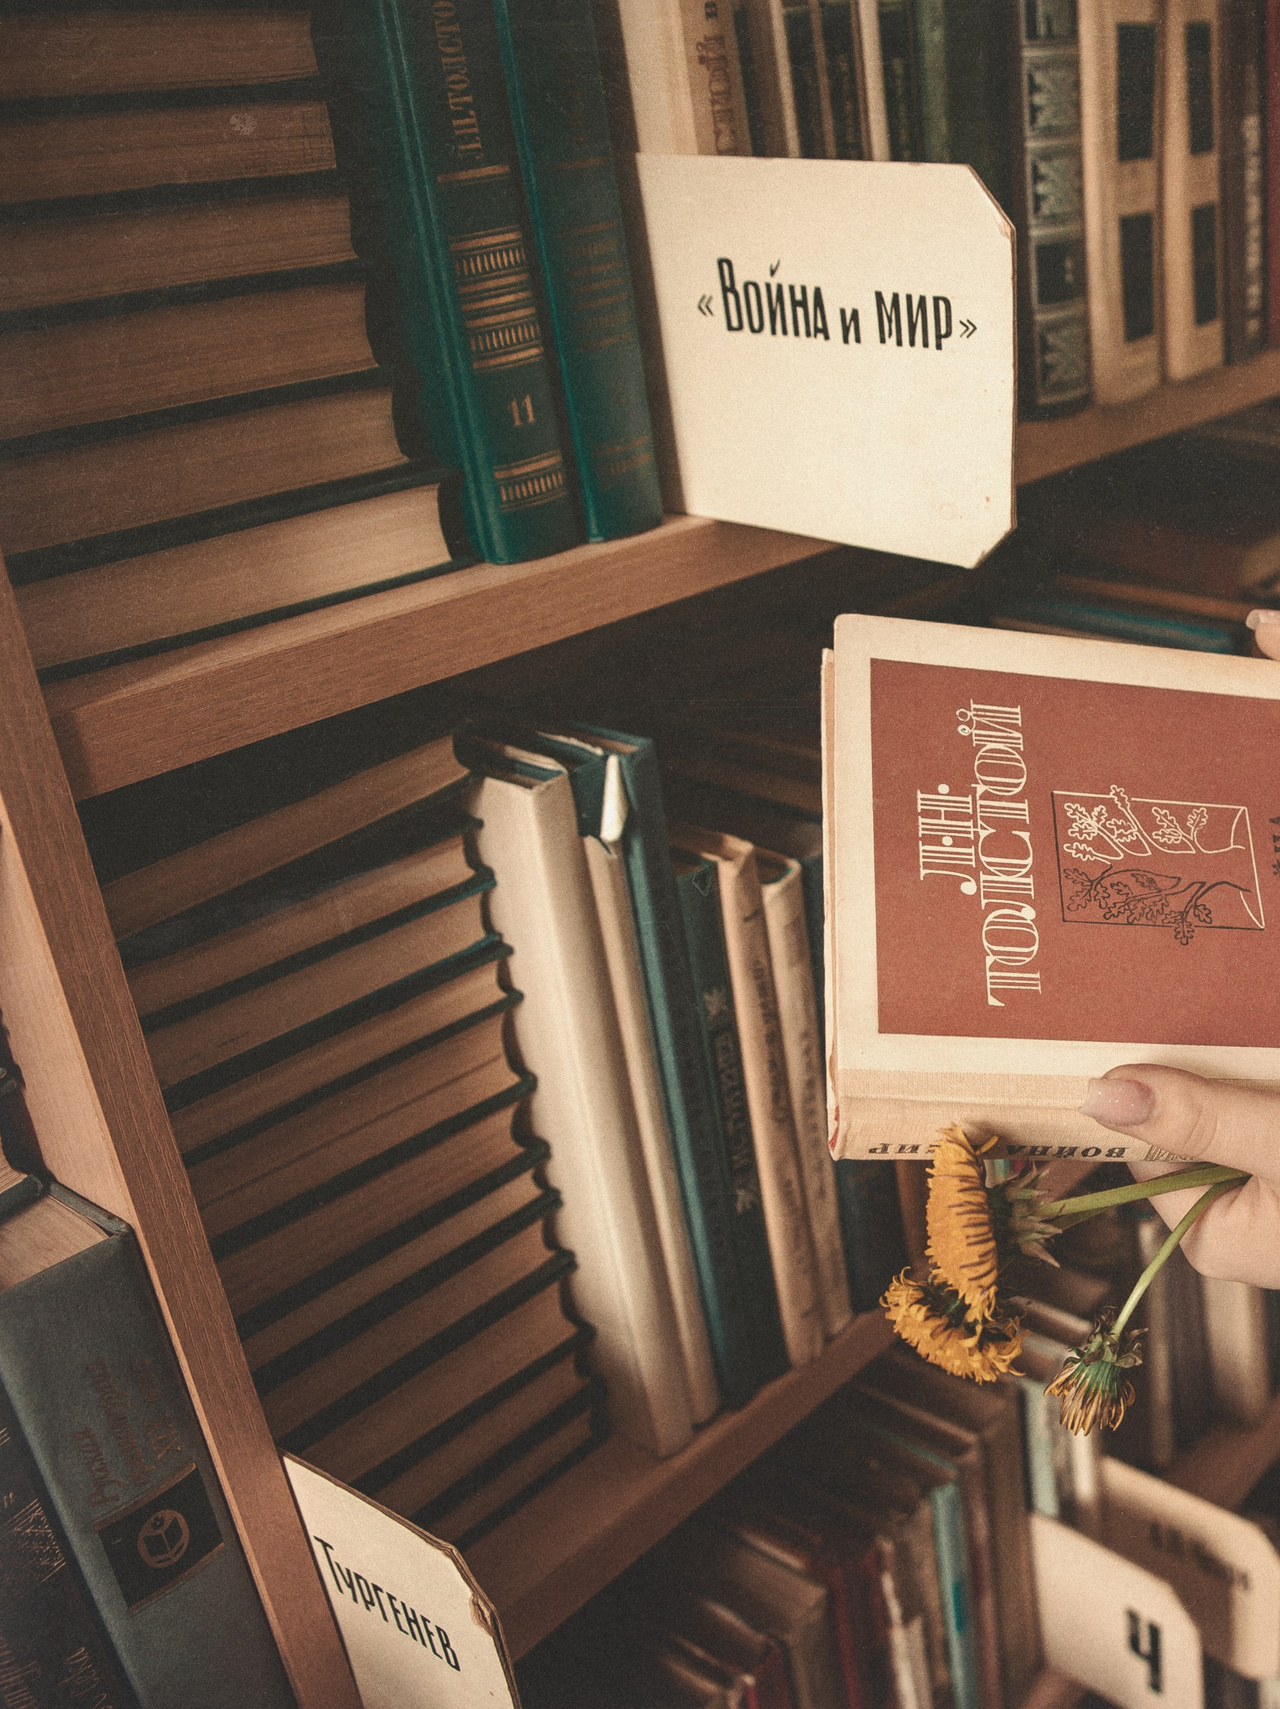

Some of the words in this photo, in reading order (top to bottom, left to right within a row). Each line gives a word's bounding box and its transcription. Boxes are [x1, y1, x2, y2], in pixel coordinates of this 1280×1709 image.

[508, 393, 536, 427] 11
[954, 698, 1042, 1007] ТОЛСТОЙ
[1005, 1144, 1132, 1159] ВОЙНА
